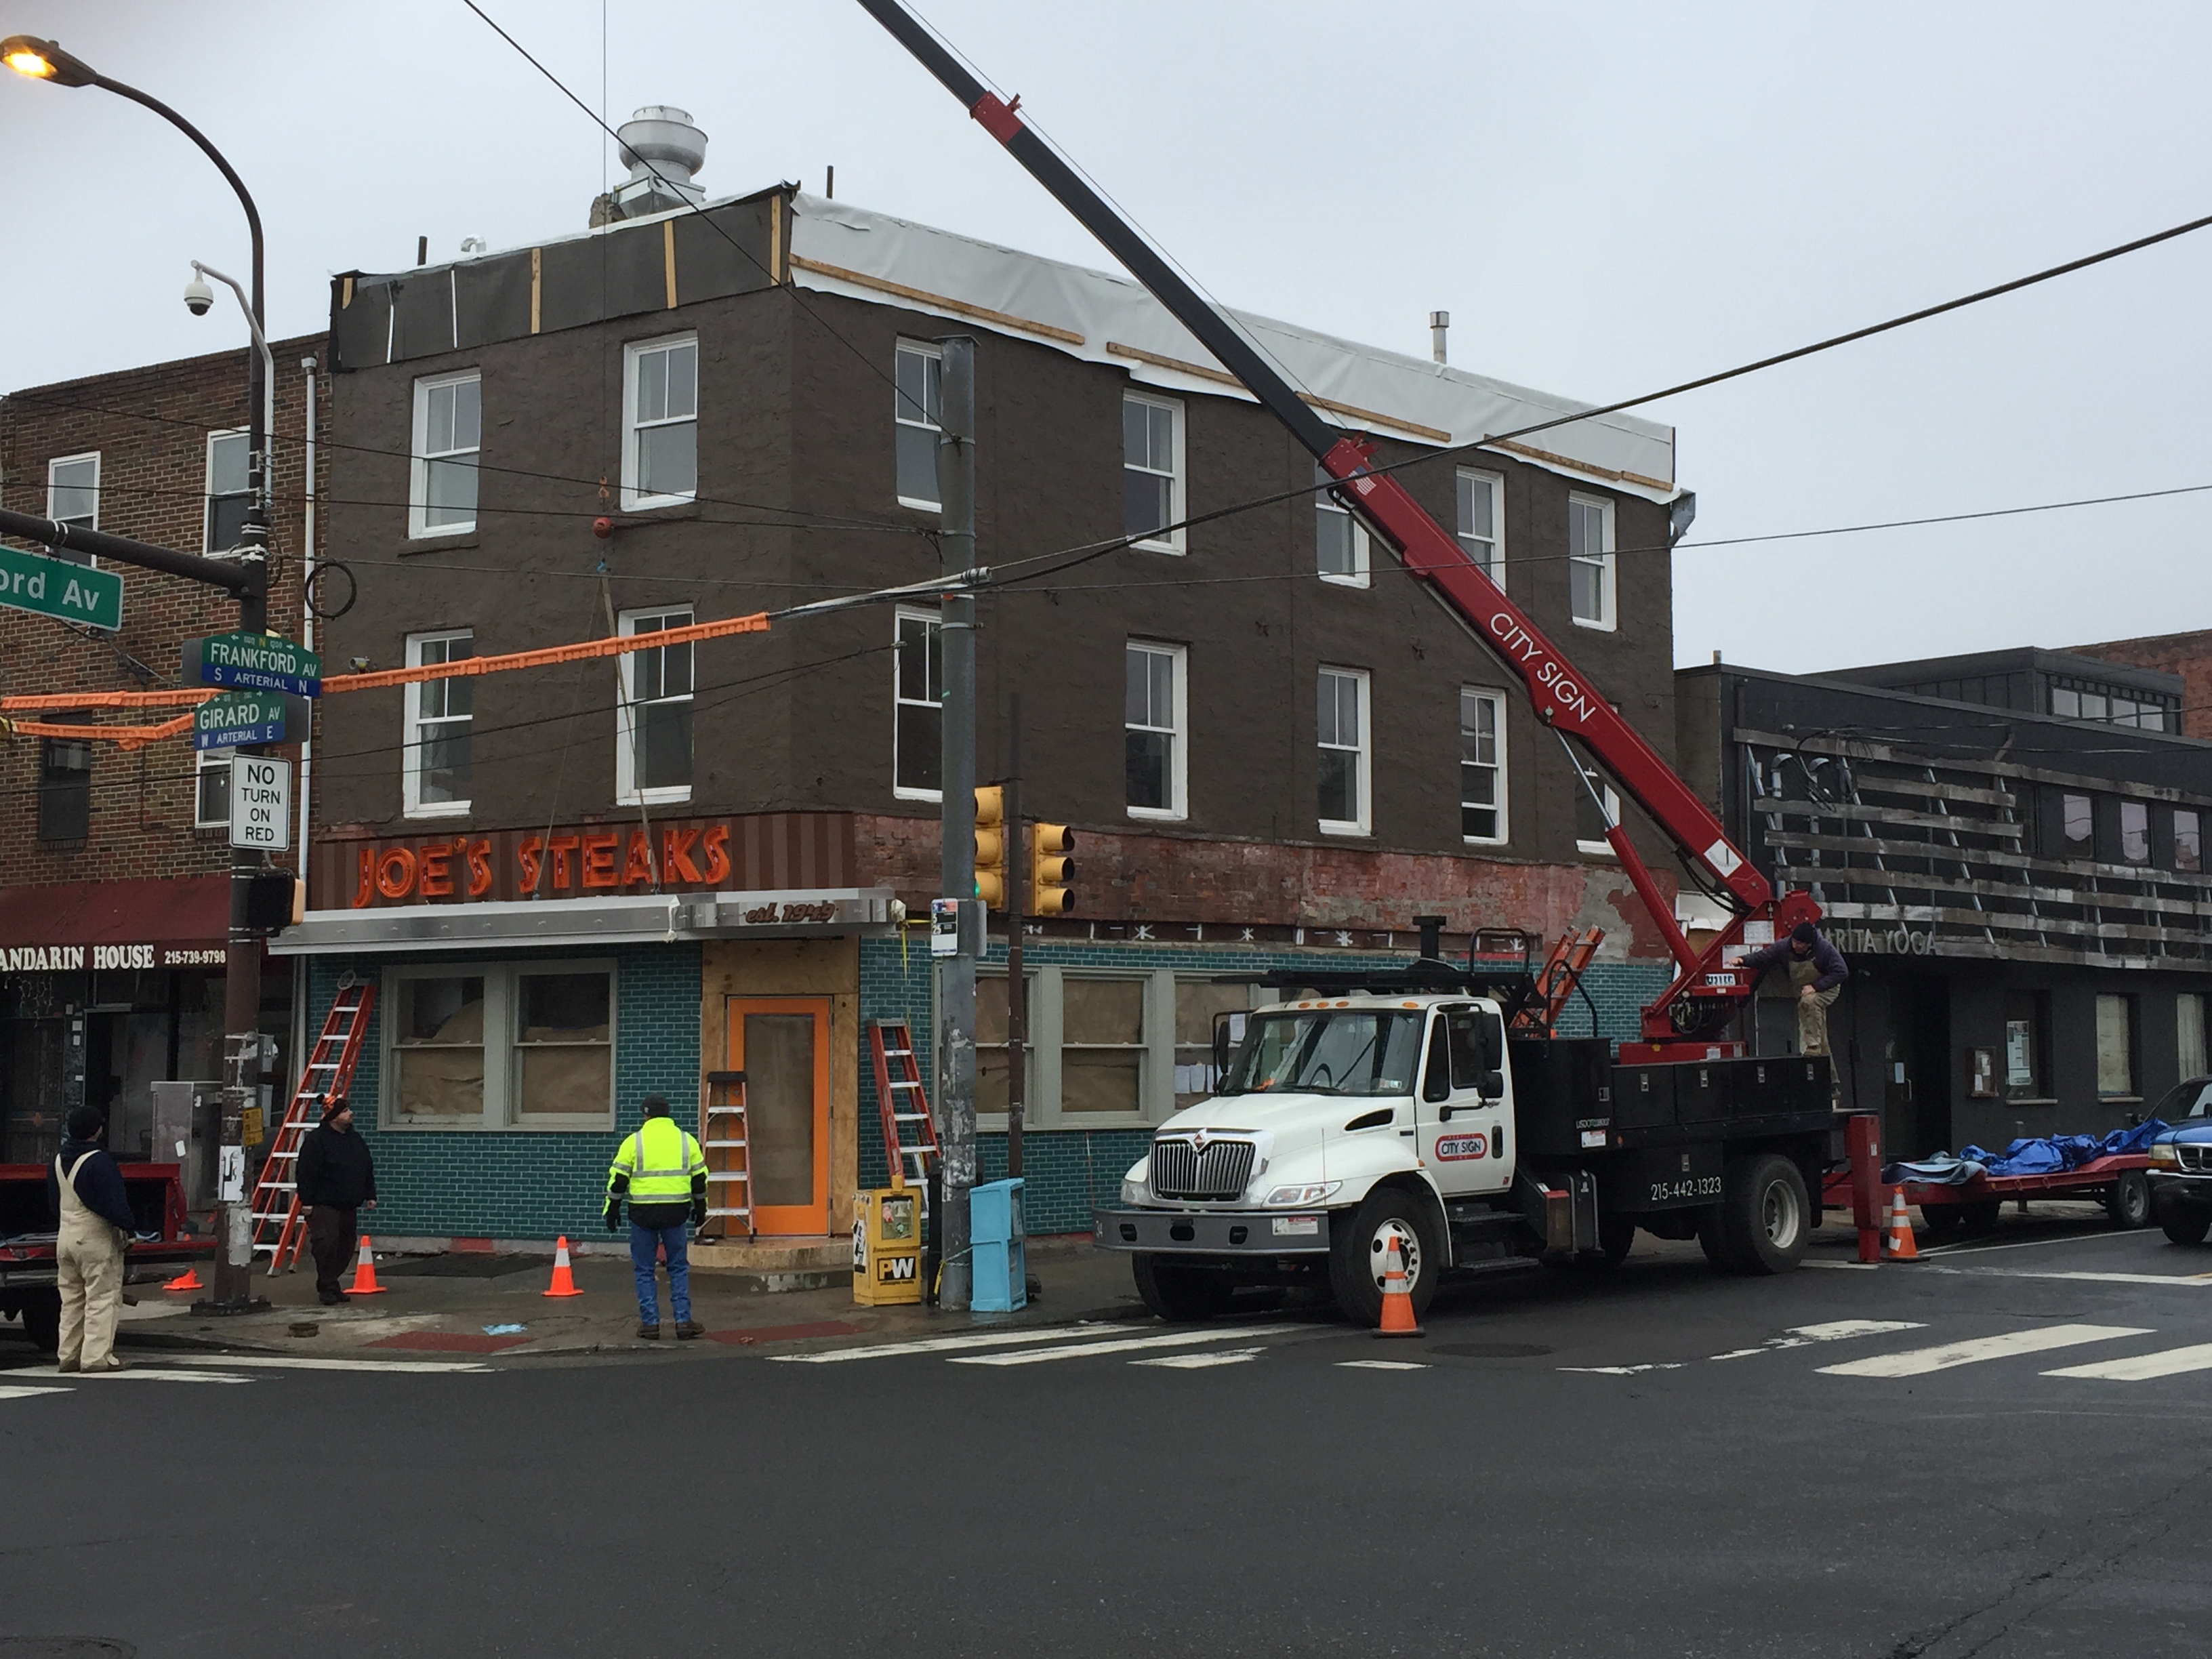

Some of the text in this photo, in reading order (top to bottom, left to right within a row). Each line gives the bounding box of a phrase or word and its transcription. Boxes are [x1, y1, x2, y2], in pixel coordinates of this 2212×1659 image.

[62, 579, 100, 611] Av
[211, 642, 316, 677] FRANKFORD AV
[1490, 613, 1596, 723] CITY SIGN
[214, 667, 307, 694] S ARTERIAL N
[200, 703, 281, 731] GIRARD AV
[201, 725, 274, 747] W ARTERIAL E
[247, 764, 275, 785] NO
[241, 787, 281, 805] TURN
[250, 807, 270, 823] ON
[245, 826, 274, 842] RED
[352, 824, 731, 909] JOE'S STEAKS
[745, 902, 836, 923] est. 1949
[1883, 927, 1937, 956] YOGA
[93, 944, 155, 970] HOUSE
[164, 949, 226, 964] 215-739-9798
[1441, 1141, 1481, 1155] CITY SIGN
[1650, 1176, 1721, 1201] 215-442-1323
[879, 1258, 914, 1279] PW
